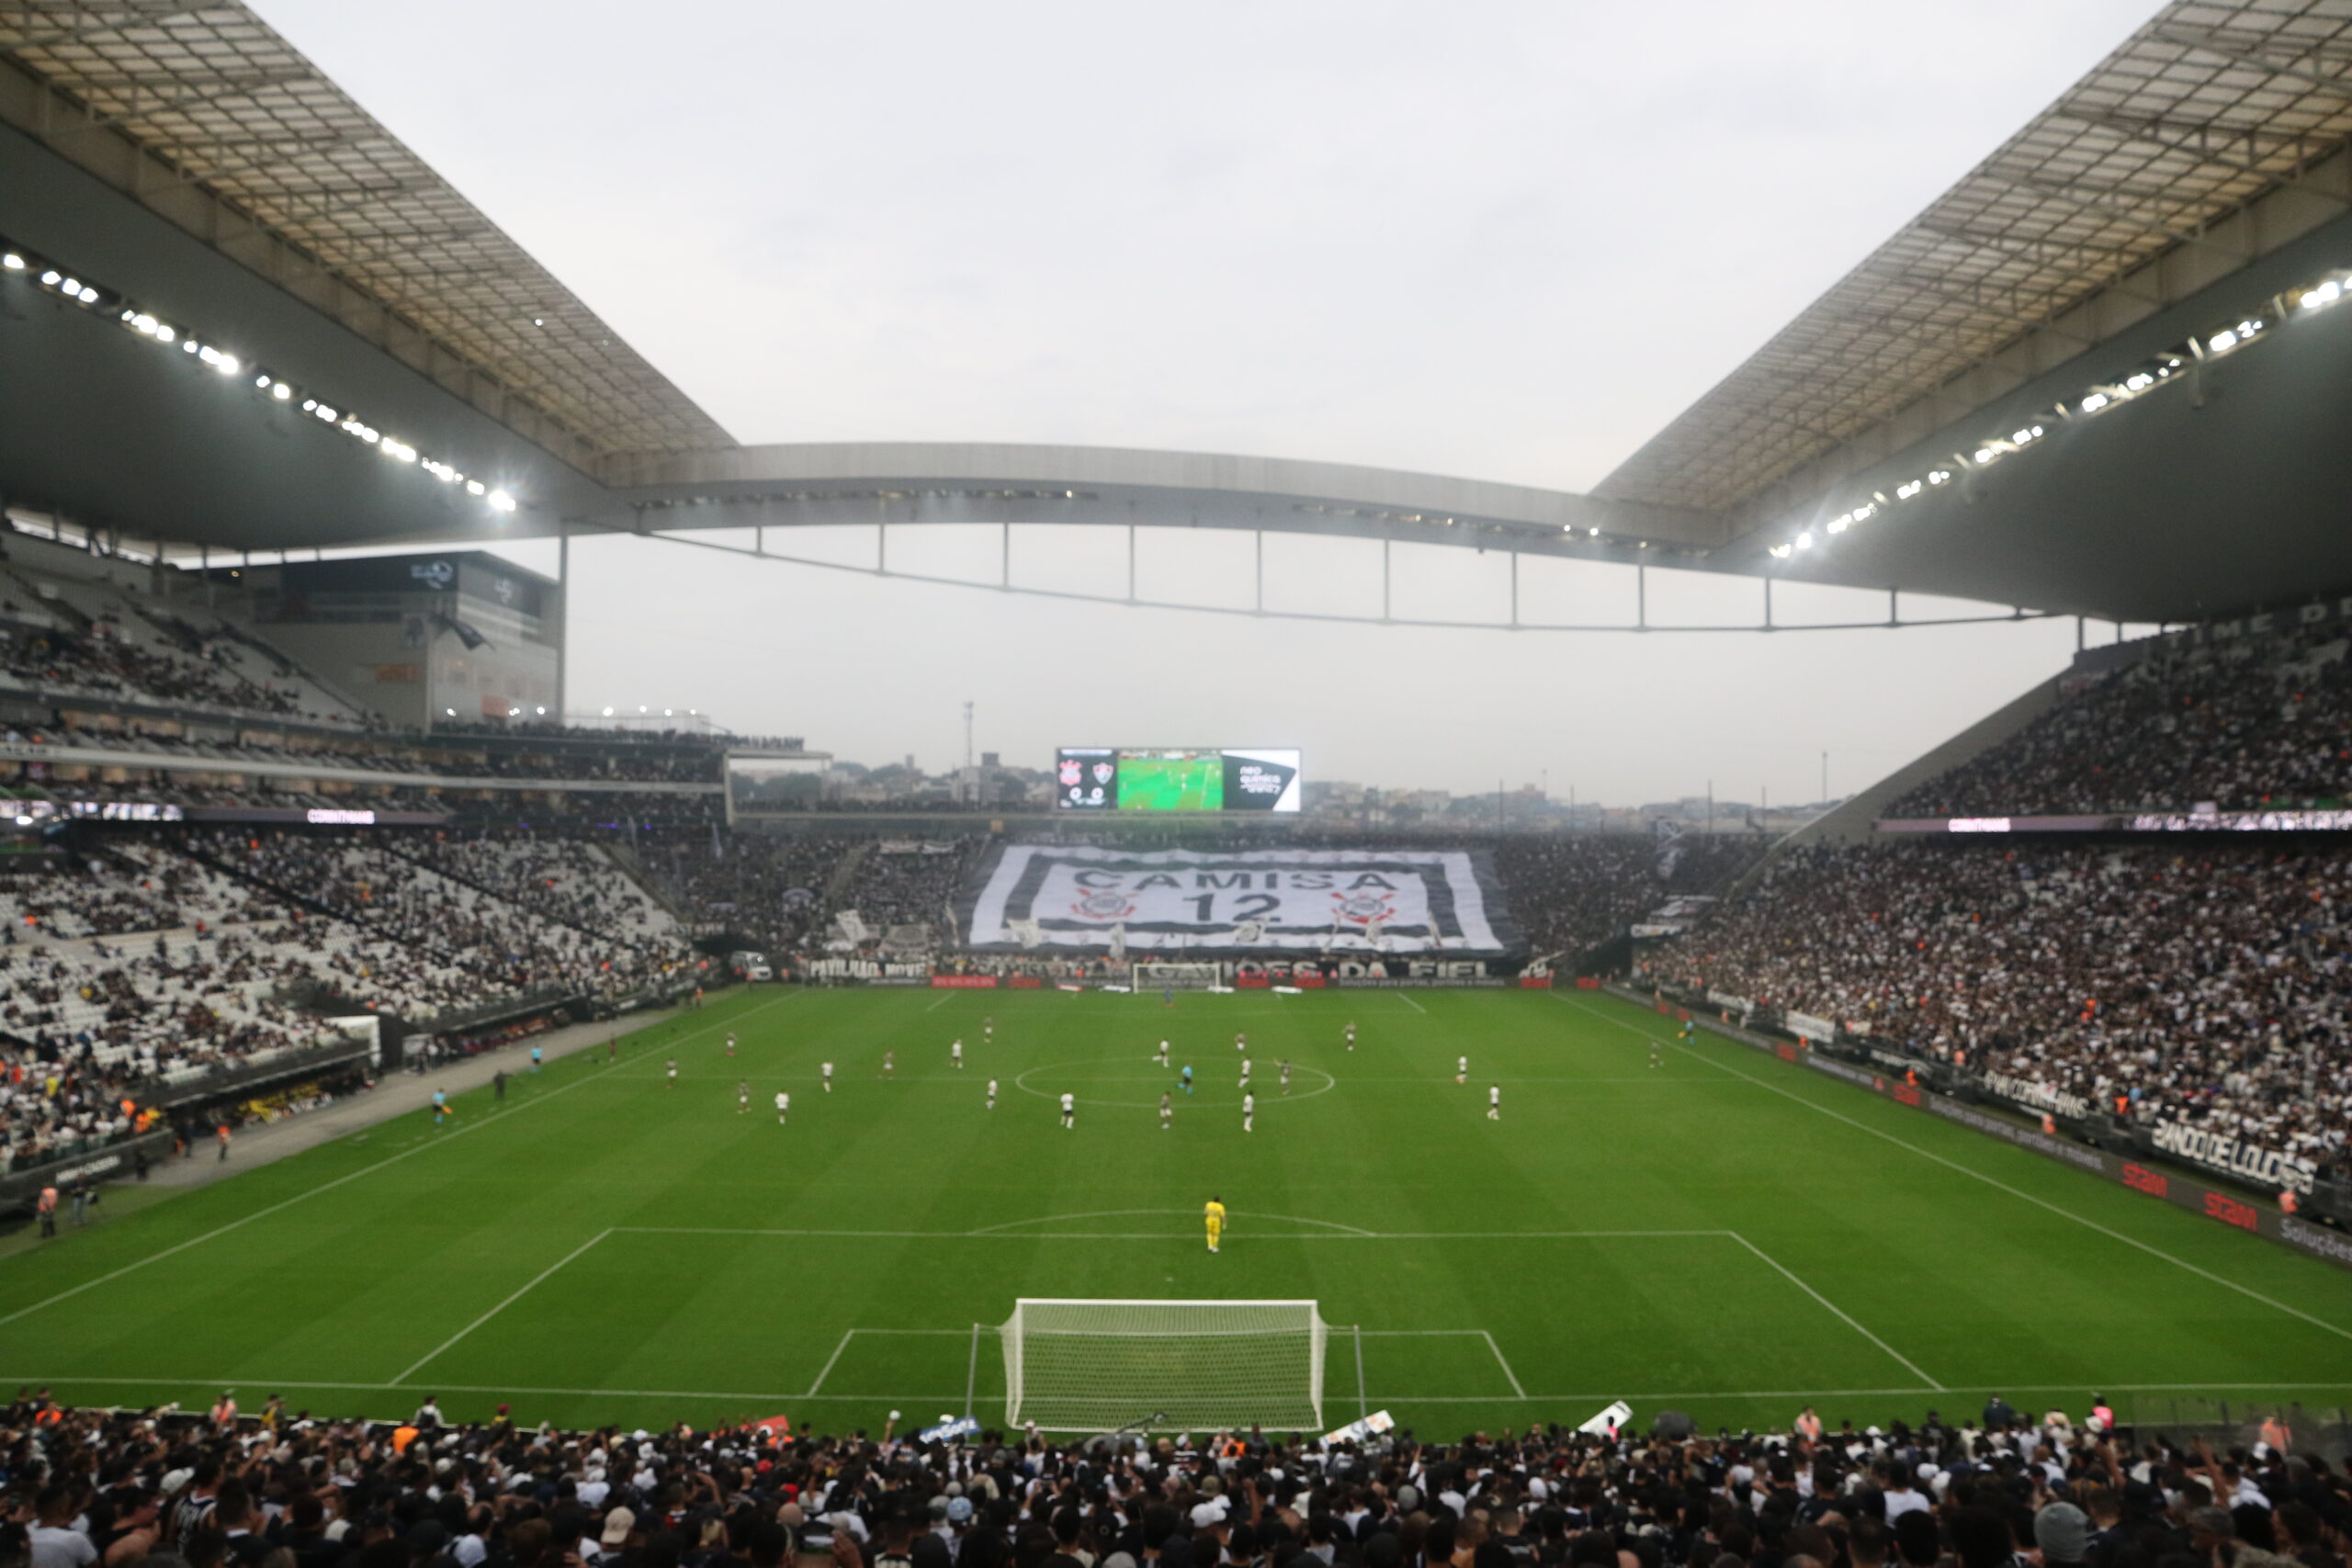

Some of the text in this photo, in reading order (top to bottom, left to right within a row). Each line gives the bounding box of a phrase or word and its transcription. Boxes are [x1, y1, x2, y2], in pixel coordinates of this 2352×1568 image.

[1074, 870, 1397, 890] CAMISA
[1183, 893, 1282, 922] 12
[1340, 961, 1388, 978] DA
[1409, 961, 1488, 978] FIEL
[2152, 1117, 2207, 1160] BANDO
[2205, 1133, 2234, 1168] DE
[2122, 1163, 2168, 1198] stam
[2205, 1192, 2257, 1232] stam
